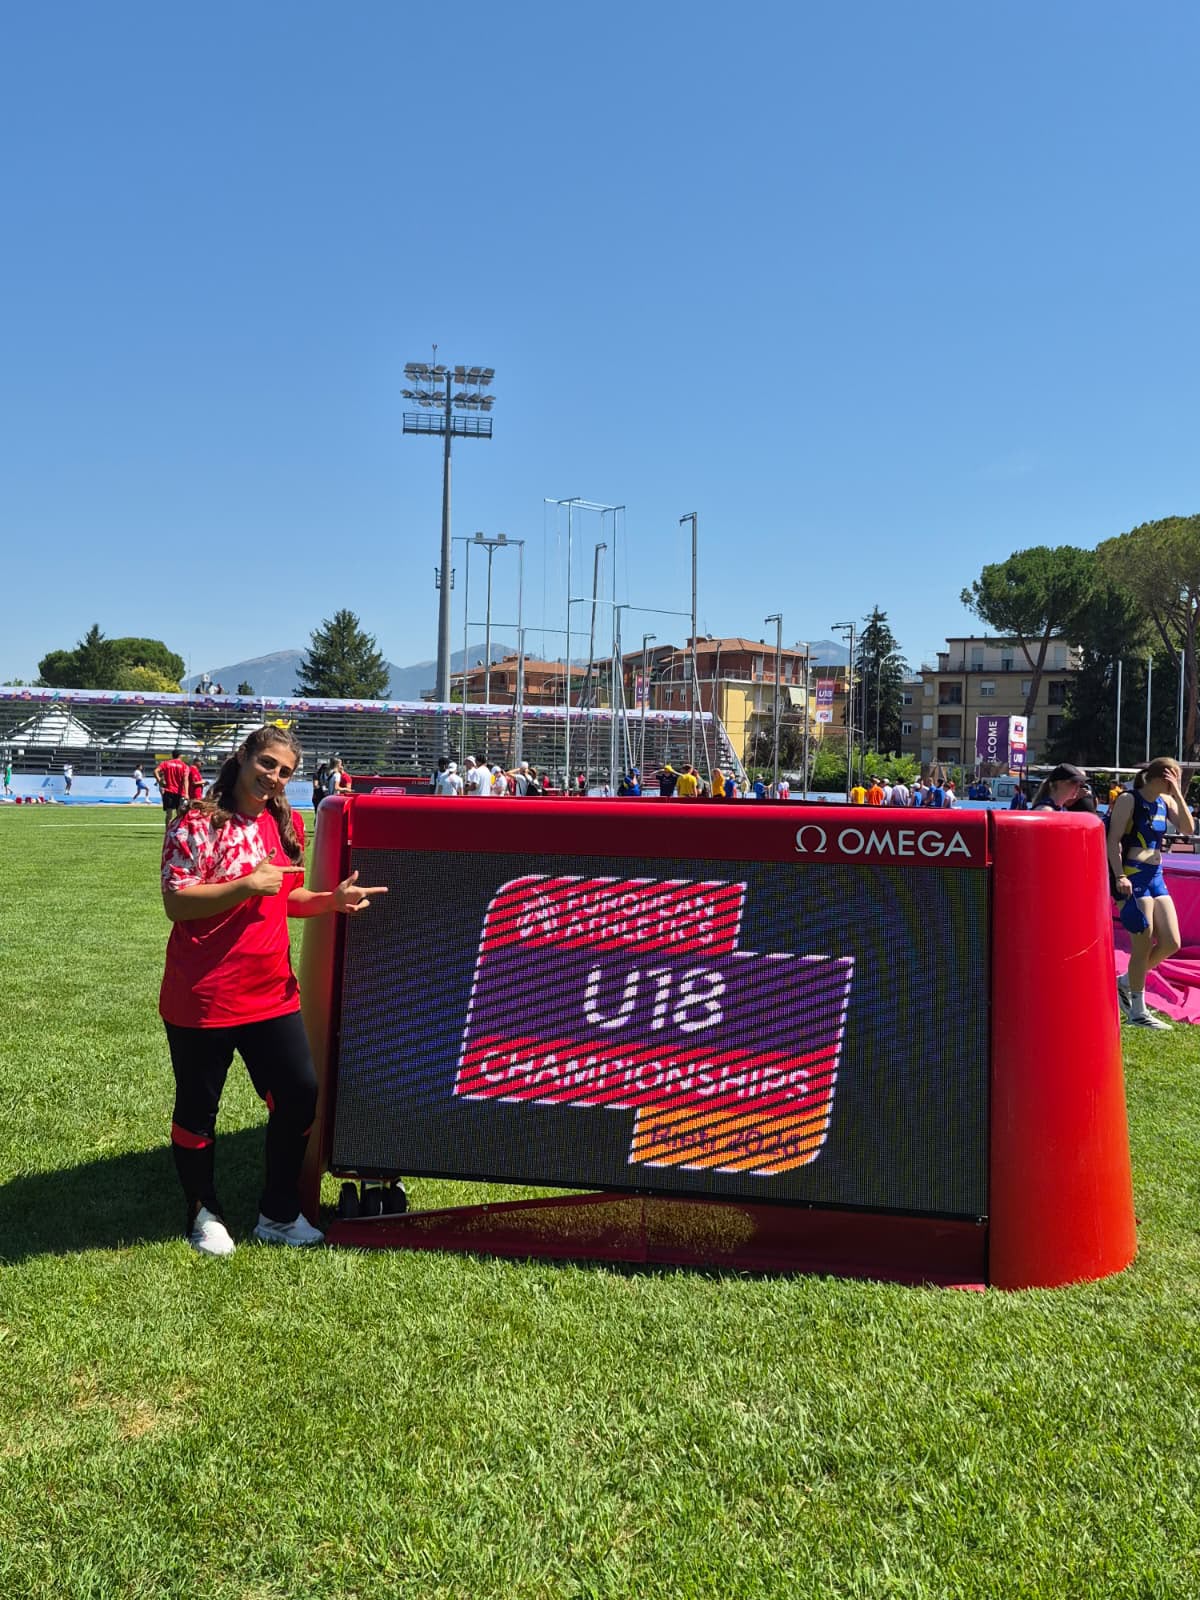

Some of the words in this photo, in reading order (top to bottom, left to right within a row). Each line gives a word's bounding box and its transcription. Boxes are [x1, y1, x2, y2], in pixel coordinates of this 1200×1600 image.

[837, 828, 972, 858] OMEGA
[583, 963, 727, 1034] U18
[479, 1050, 811, 1102] CHAMPIONSHIPS
